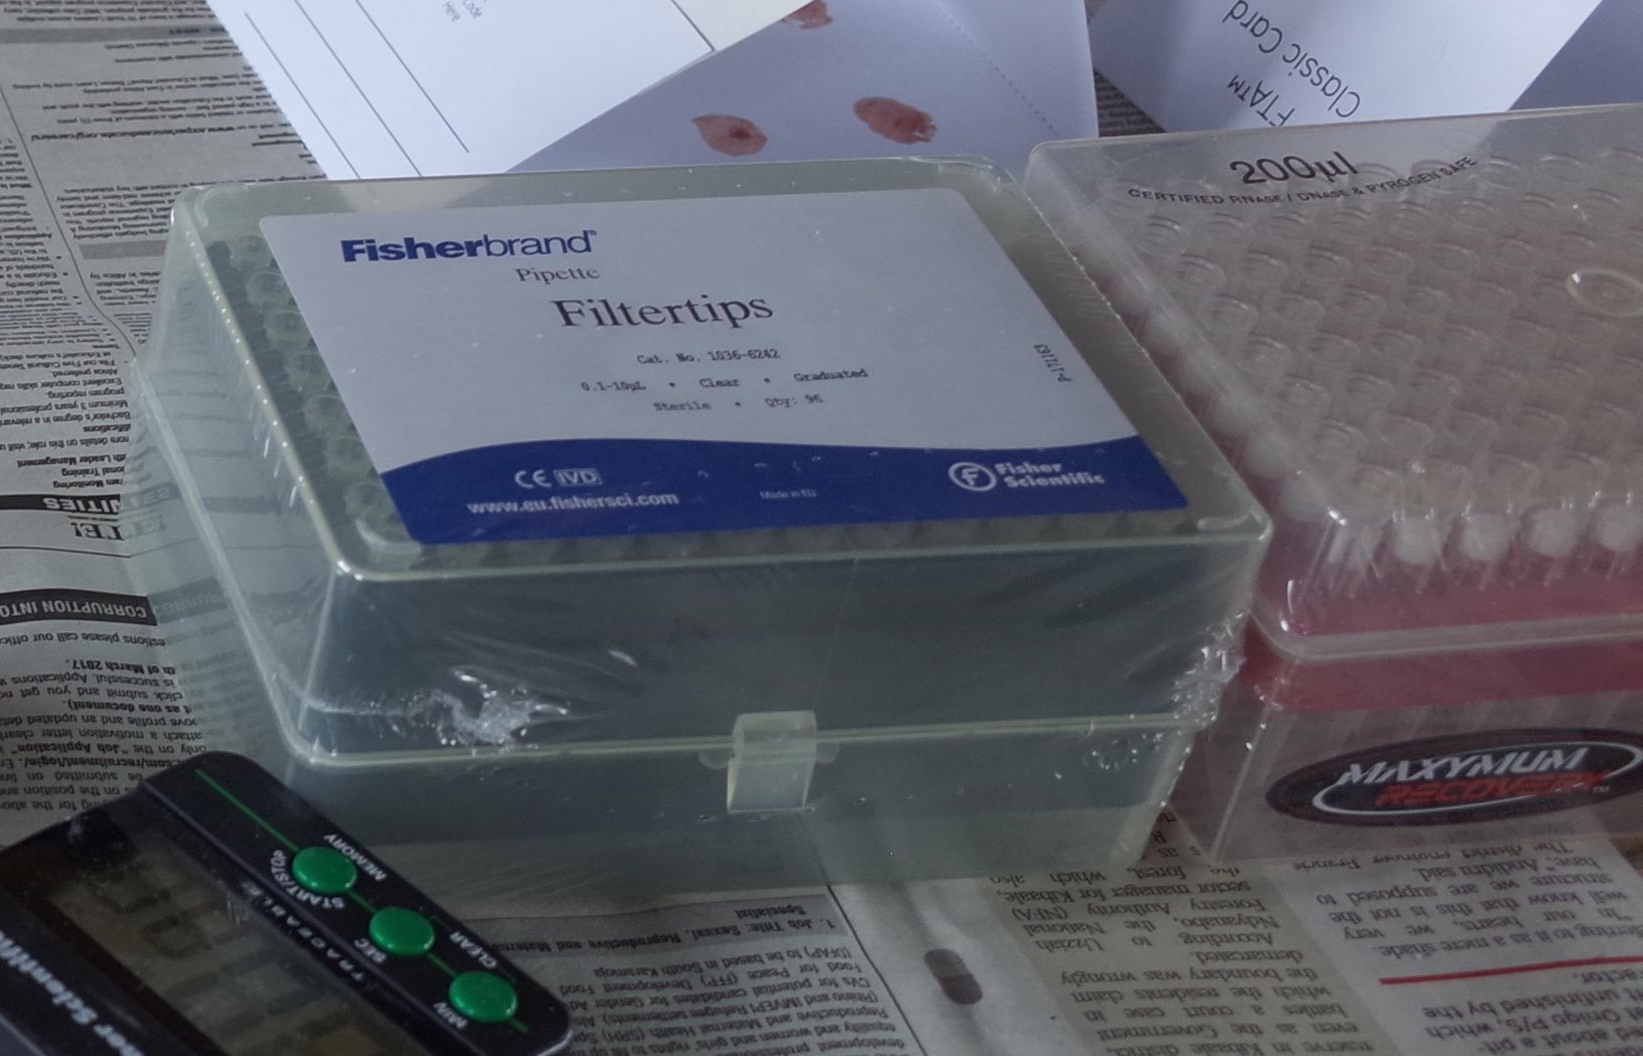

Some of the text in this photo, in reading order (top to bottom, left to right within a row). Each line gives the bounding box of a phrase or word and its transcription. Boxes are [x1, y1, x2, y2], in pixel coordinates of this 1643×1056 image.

[1222, 0, 1361, 118] Classic Card
[1128, 188, 1224, 205] CERTIFIED
[1230, 193, 1282, 204] RNASE
[1297, 189, 1348, 201] DNASE
[1367, 170, 1440, 194] PYROGEN
[1443, 155, 1478, 176] SAFE
[1230, 151, 1358, 185] 200µl
[515, 267, 600, 284] Pipette
[550, 294, 774, 329] Filtertips
[636, 353, 665, 365] Cat.
[676, 352, 701, 363] No.
[698, 375, 740, 388] Clear
[793, 368, 869, 382] Graduated
[653, 400, 711, 412] Sterile
[995, 462, 1061, 476] Fisher
[1005, 471, 1105, 489] Scientific
[467, 490, 679, 515] www.eu.fishersci.com
[41, 600, 147, 619] CORRUPTION
[1337, 747, 1589, 785] MAXYMUM
[323, 831, 387, 882] MEMORY
[353, 937, 387, 963] SEC
[449, 931, 497, 970] CLEAR
[433, 1002, 468, 1030] MIN
